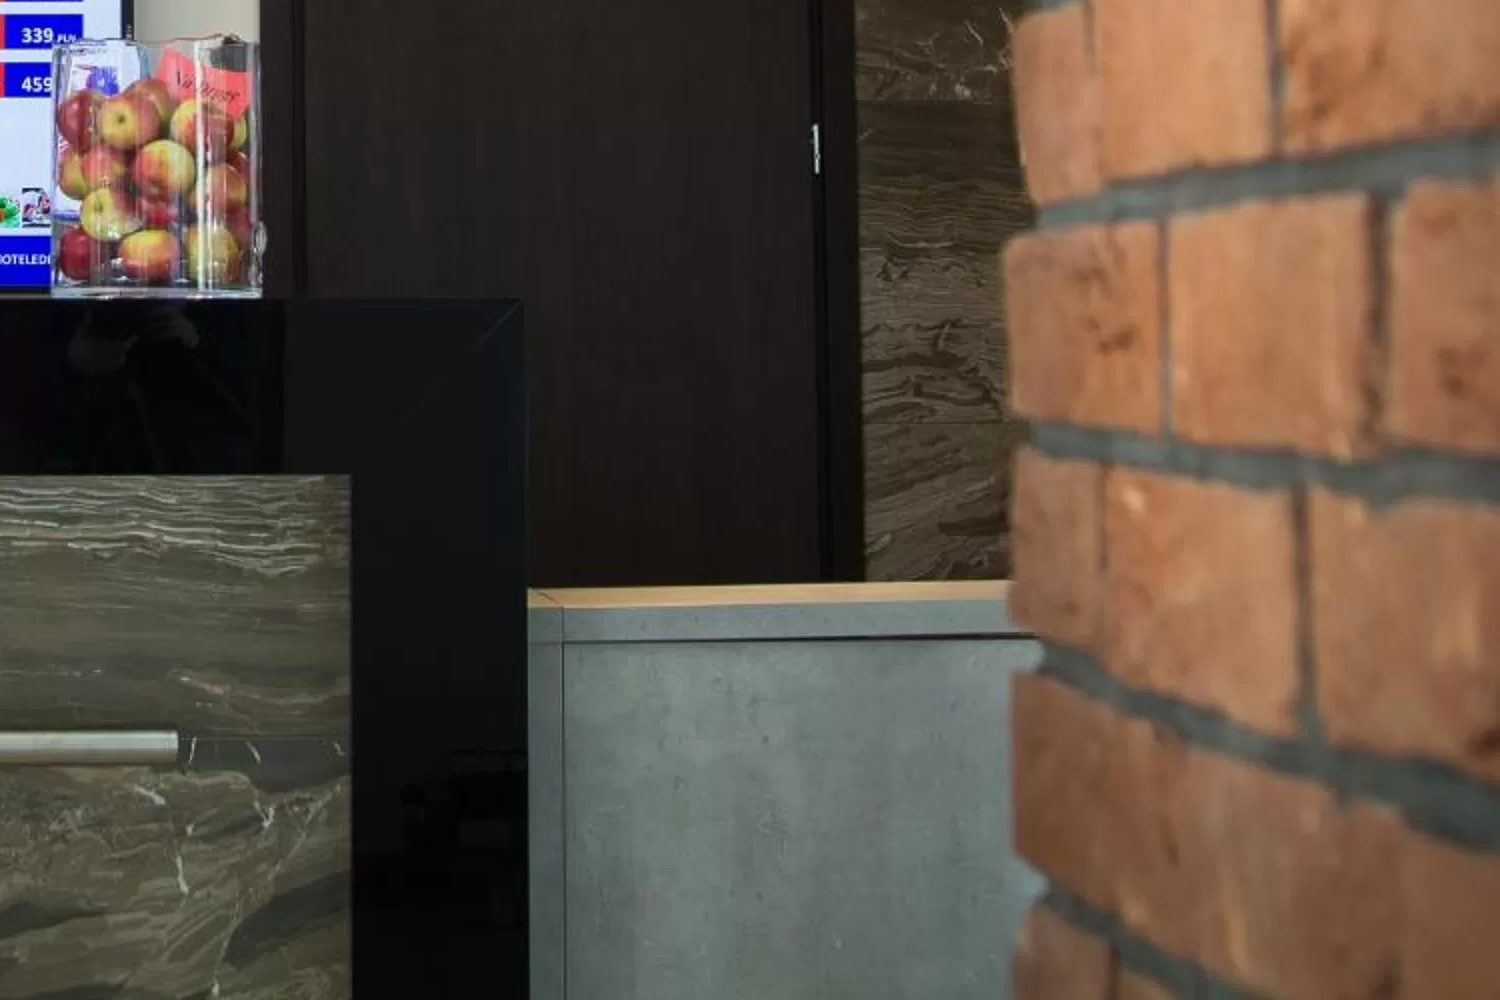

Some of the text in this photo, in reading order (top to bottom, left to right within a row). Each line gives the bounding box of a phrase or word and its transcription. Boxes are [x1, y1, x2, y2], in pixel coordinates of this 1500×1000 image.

[21, 27, 54, 44] 339
[56, 33, 77, 43] PLN
[21, 76, 53, 93] 459
